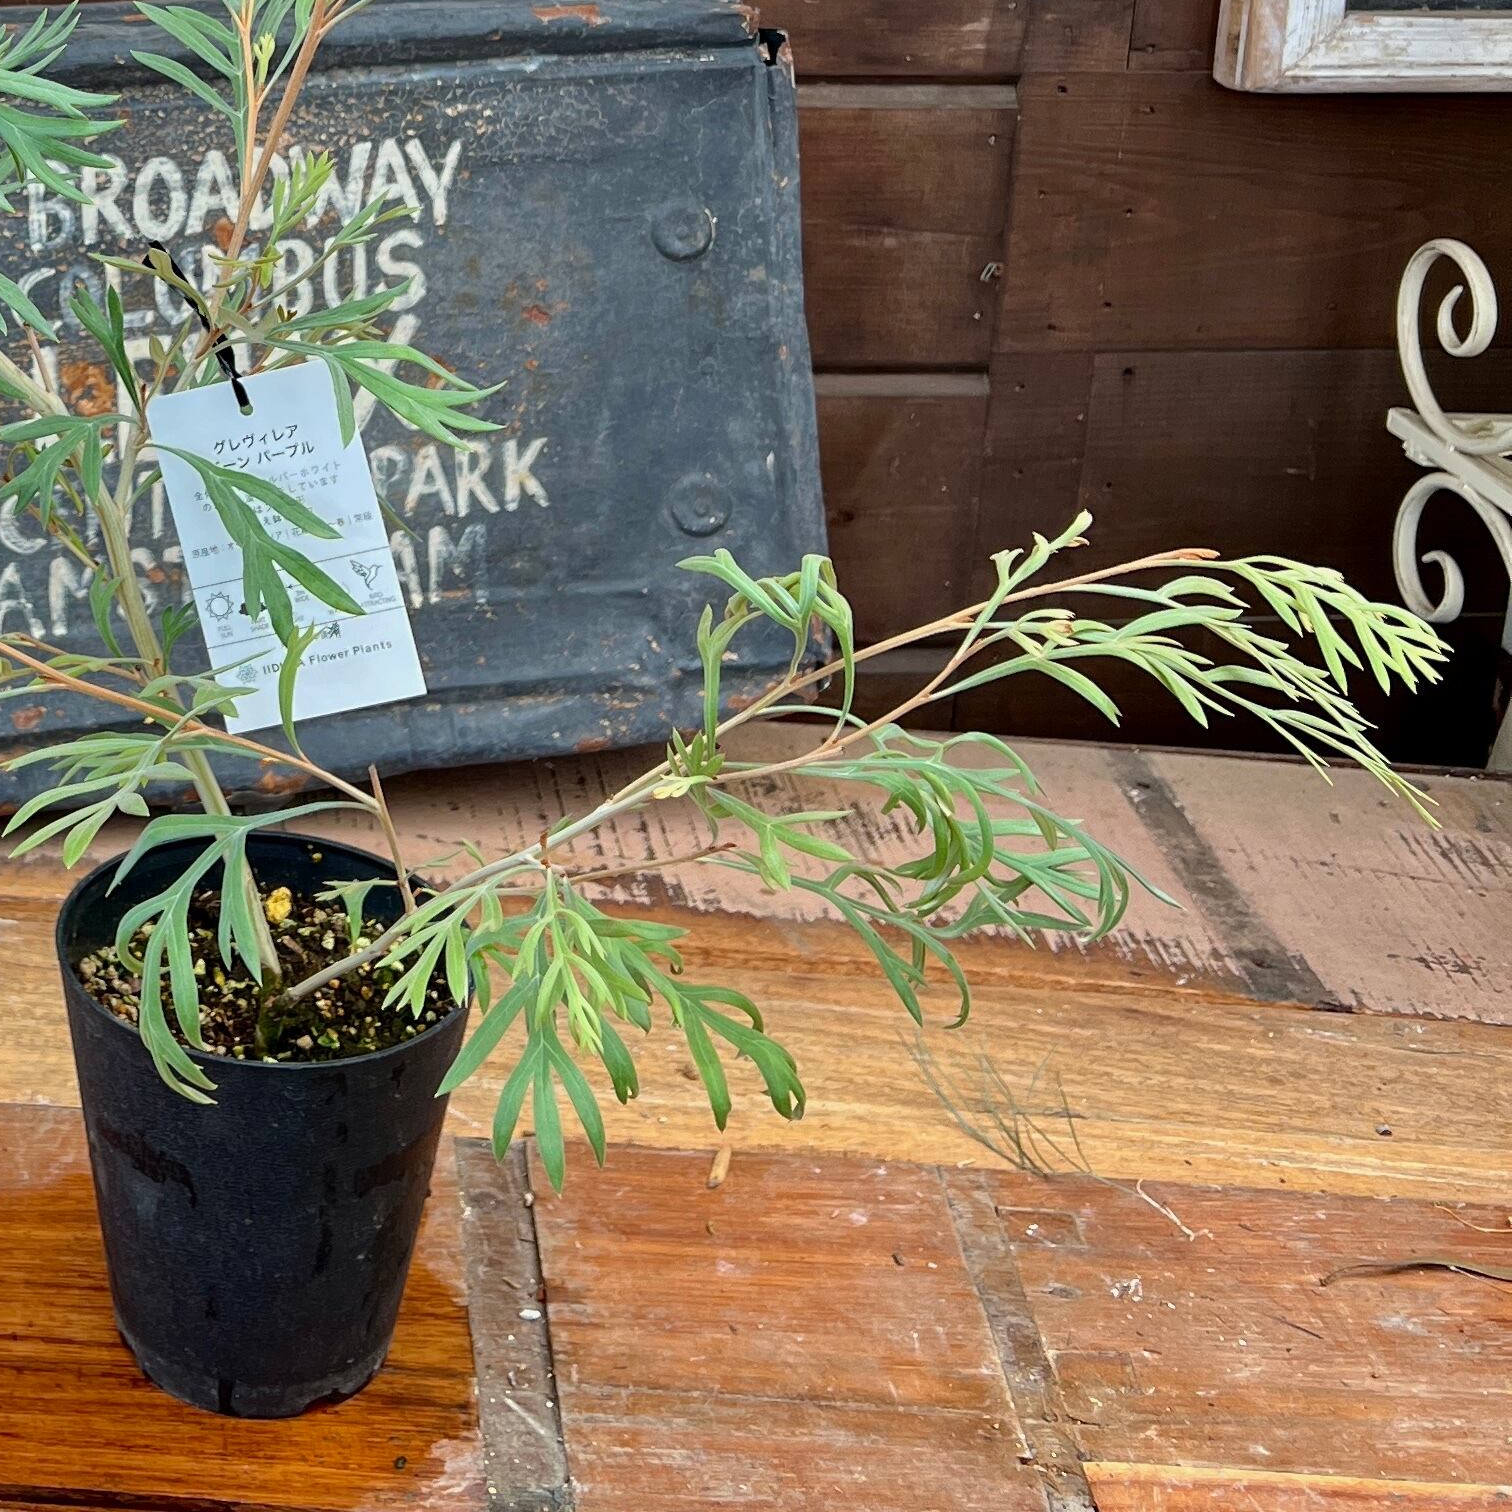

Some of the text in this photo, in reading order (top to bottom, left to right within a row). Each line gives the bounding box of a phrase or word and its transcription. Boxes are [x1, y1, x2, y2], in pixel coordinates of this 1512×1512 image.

[213, 424, 299, 456] グレヴィレア
[366, 436, 551, 518] PARK
[308, 648, 350, 666] Flower
[352, 639, 393, 656] Plants
